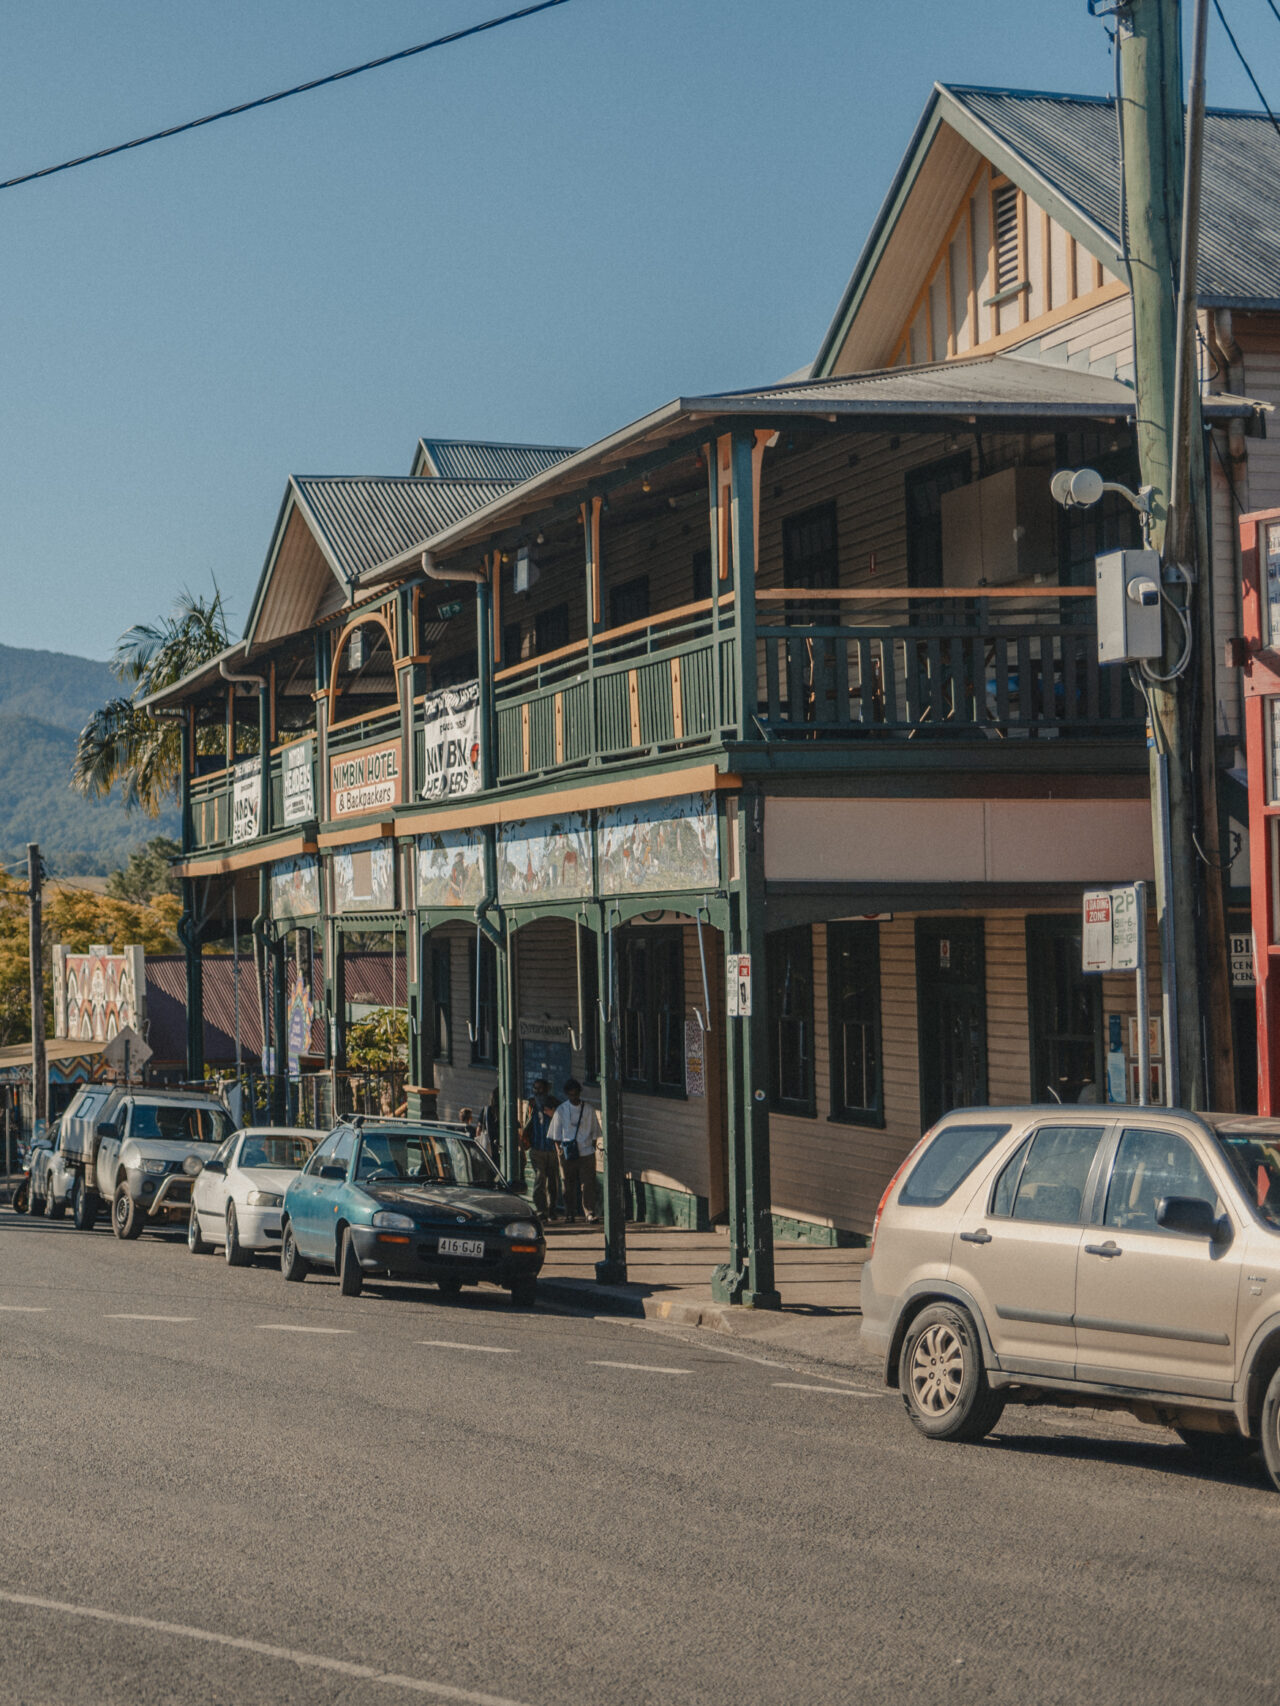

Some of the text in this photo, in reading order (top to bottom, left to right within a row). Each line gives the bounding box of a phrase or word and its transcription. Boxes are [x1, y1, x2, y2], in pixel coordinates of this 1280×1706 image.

[333, 750, 398, 791] NIMBIN HOTEL
[339, 785, 391, 811] & Backpackers
[1085, 898, 1109, 911] LOADING
[1114, 894, 1135, 913] 2P
[1089, 911, 1107, 922] ZONE
[728, 960, 737, 974] 2P
